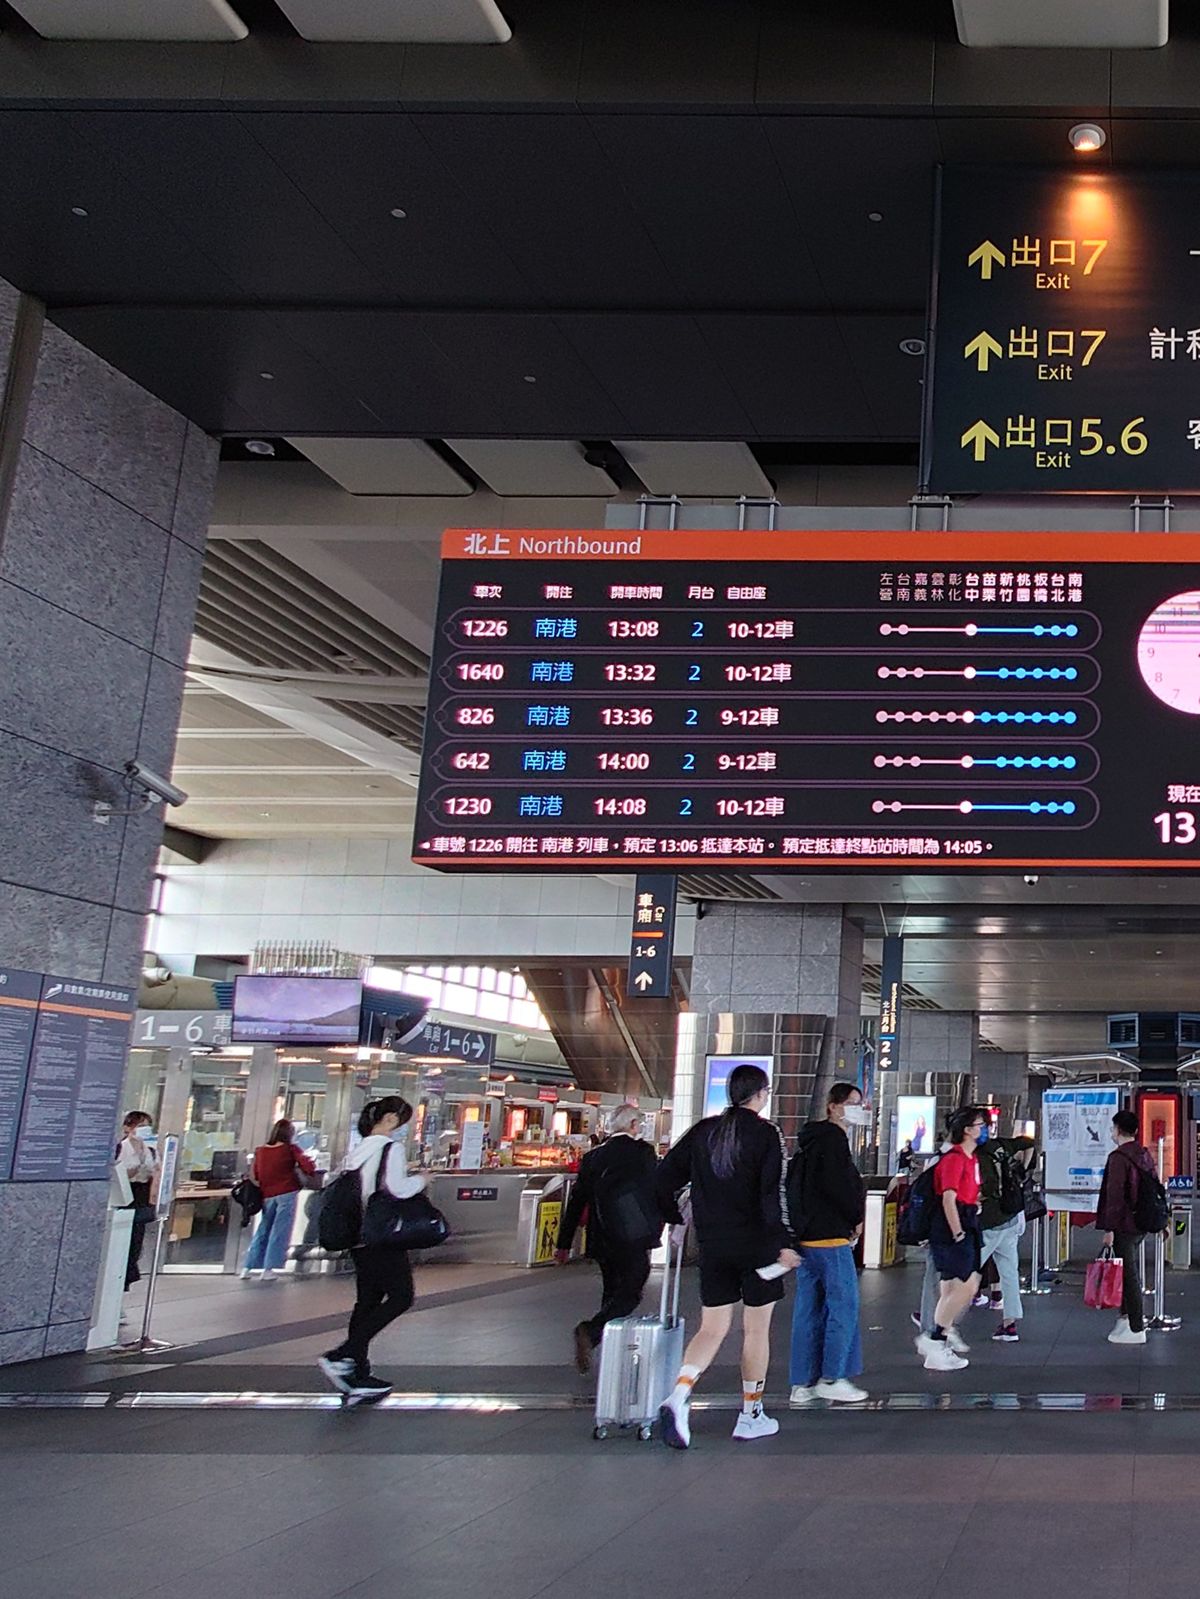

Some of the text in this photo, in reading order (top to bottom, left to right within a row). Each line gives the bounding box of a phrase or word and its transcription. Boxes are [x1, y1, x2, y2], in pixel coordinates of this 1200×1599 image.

[1035, 272, 1071, 290] Exit
[1037, 363, 1074, 382] Exit
[1035, 451, 1071, 469] Exit
[464, 534, 642, 555] 北上 Northbound
[475, 586, 766, 599] 車次 開往 開車時間 月台 自由座
[464, 618, 793, 639] 1226 南港 13:08 2 10-12車
[1147, 648, 1155, 659] 9
[459, 662, 791, 682] 1640 南港 13:32 2 10-12車
[1155, 672, 1163, 683] 8
[1173, 689, 1180, 700] 7
[458, 706, 778, 726] 826 南港 13:36 2 9-12車
[455, 750, 776, 771] 642 南港 14:00 2 9-12車
[446, 795, 784, 816] 1230 南港 14:08 2 10-12車
[433, 837, 465, 853] 車號
[469, 839, 503, 852] 1226
[506, 838, 537, 853] 開往
[542, 838, 573, 853] 南港
[660, 840, 698, 853] 13:06
[638, 894, 653, 923] 車廂
[655, 907, 665, 922] Car
[636, 947, 656, 958] 1-6
[442, 1029, 471, 1055] 1-6
[882, 1041, 890, 1052] 2
